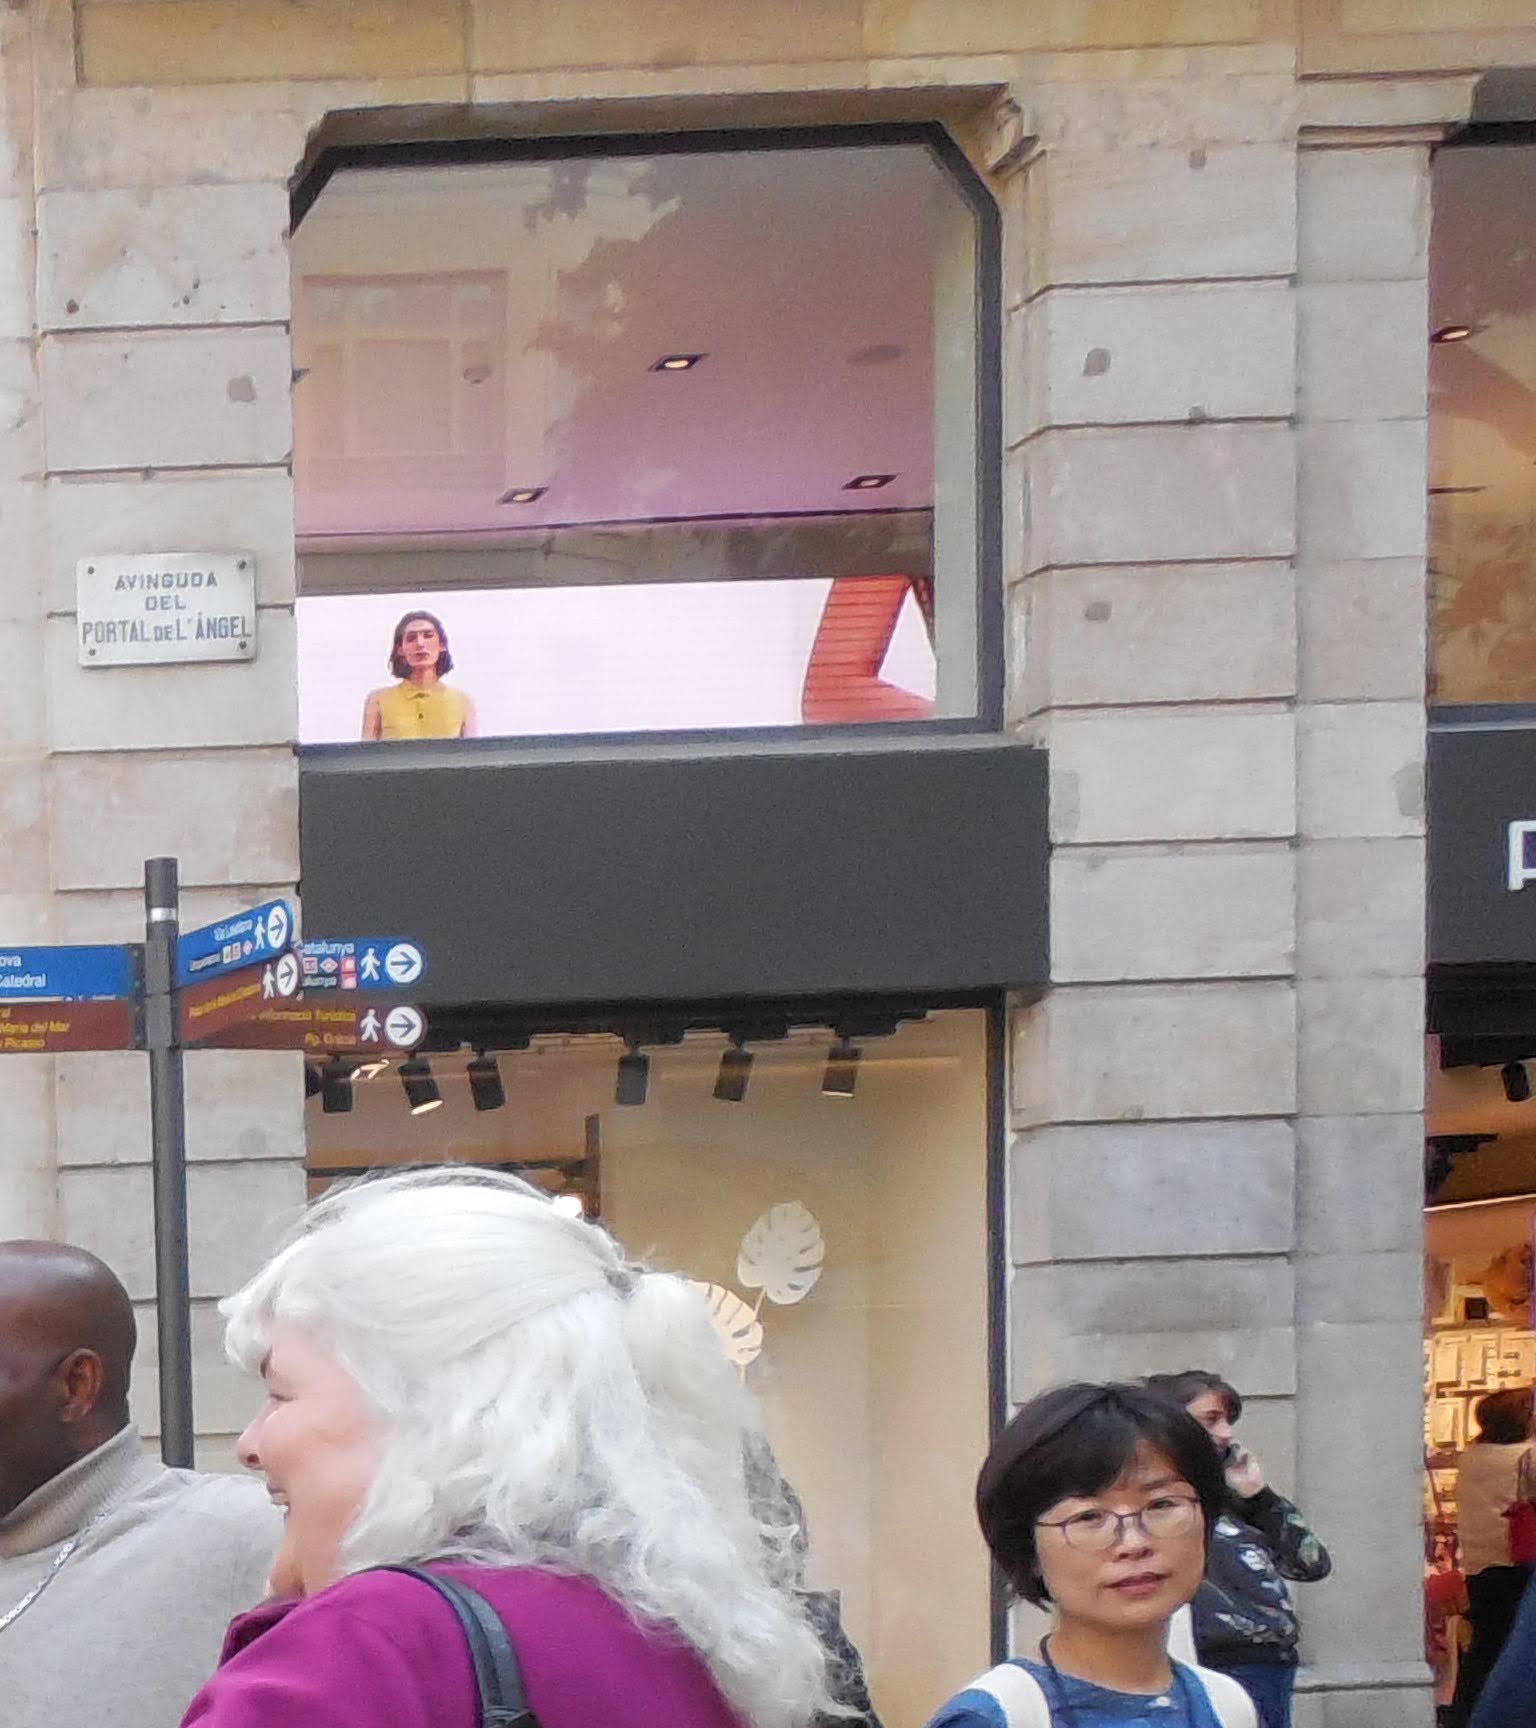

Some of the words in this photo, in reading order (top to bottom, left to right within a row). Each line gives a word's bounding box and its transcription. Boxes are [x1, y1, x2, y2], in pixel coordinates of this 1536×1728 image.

[115, 571, 218, 591] AVINGUDA
[145, 594, 186, 612] DEL
[81, 619, 151, 645] PORTAL
